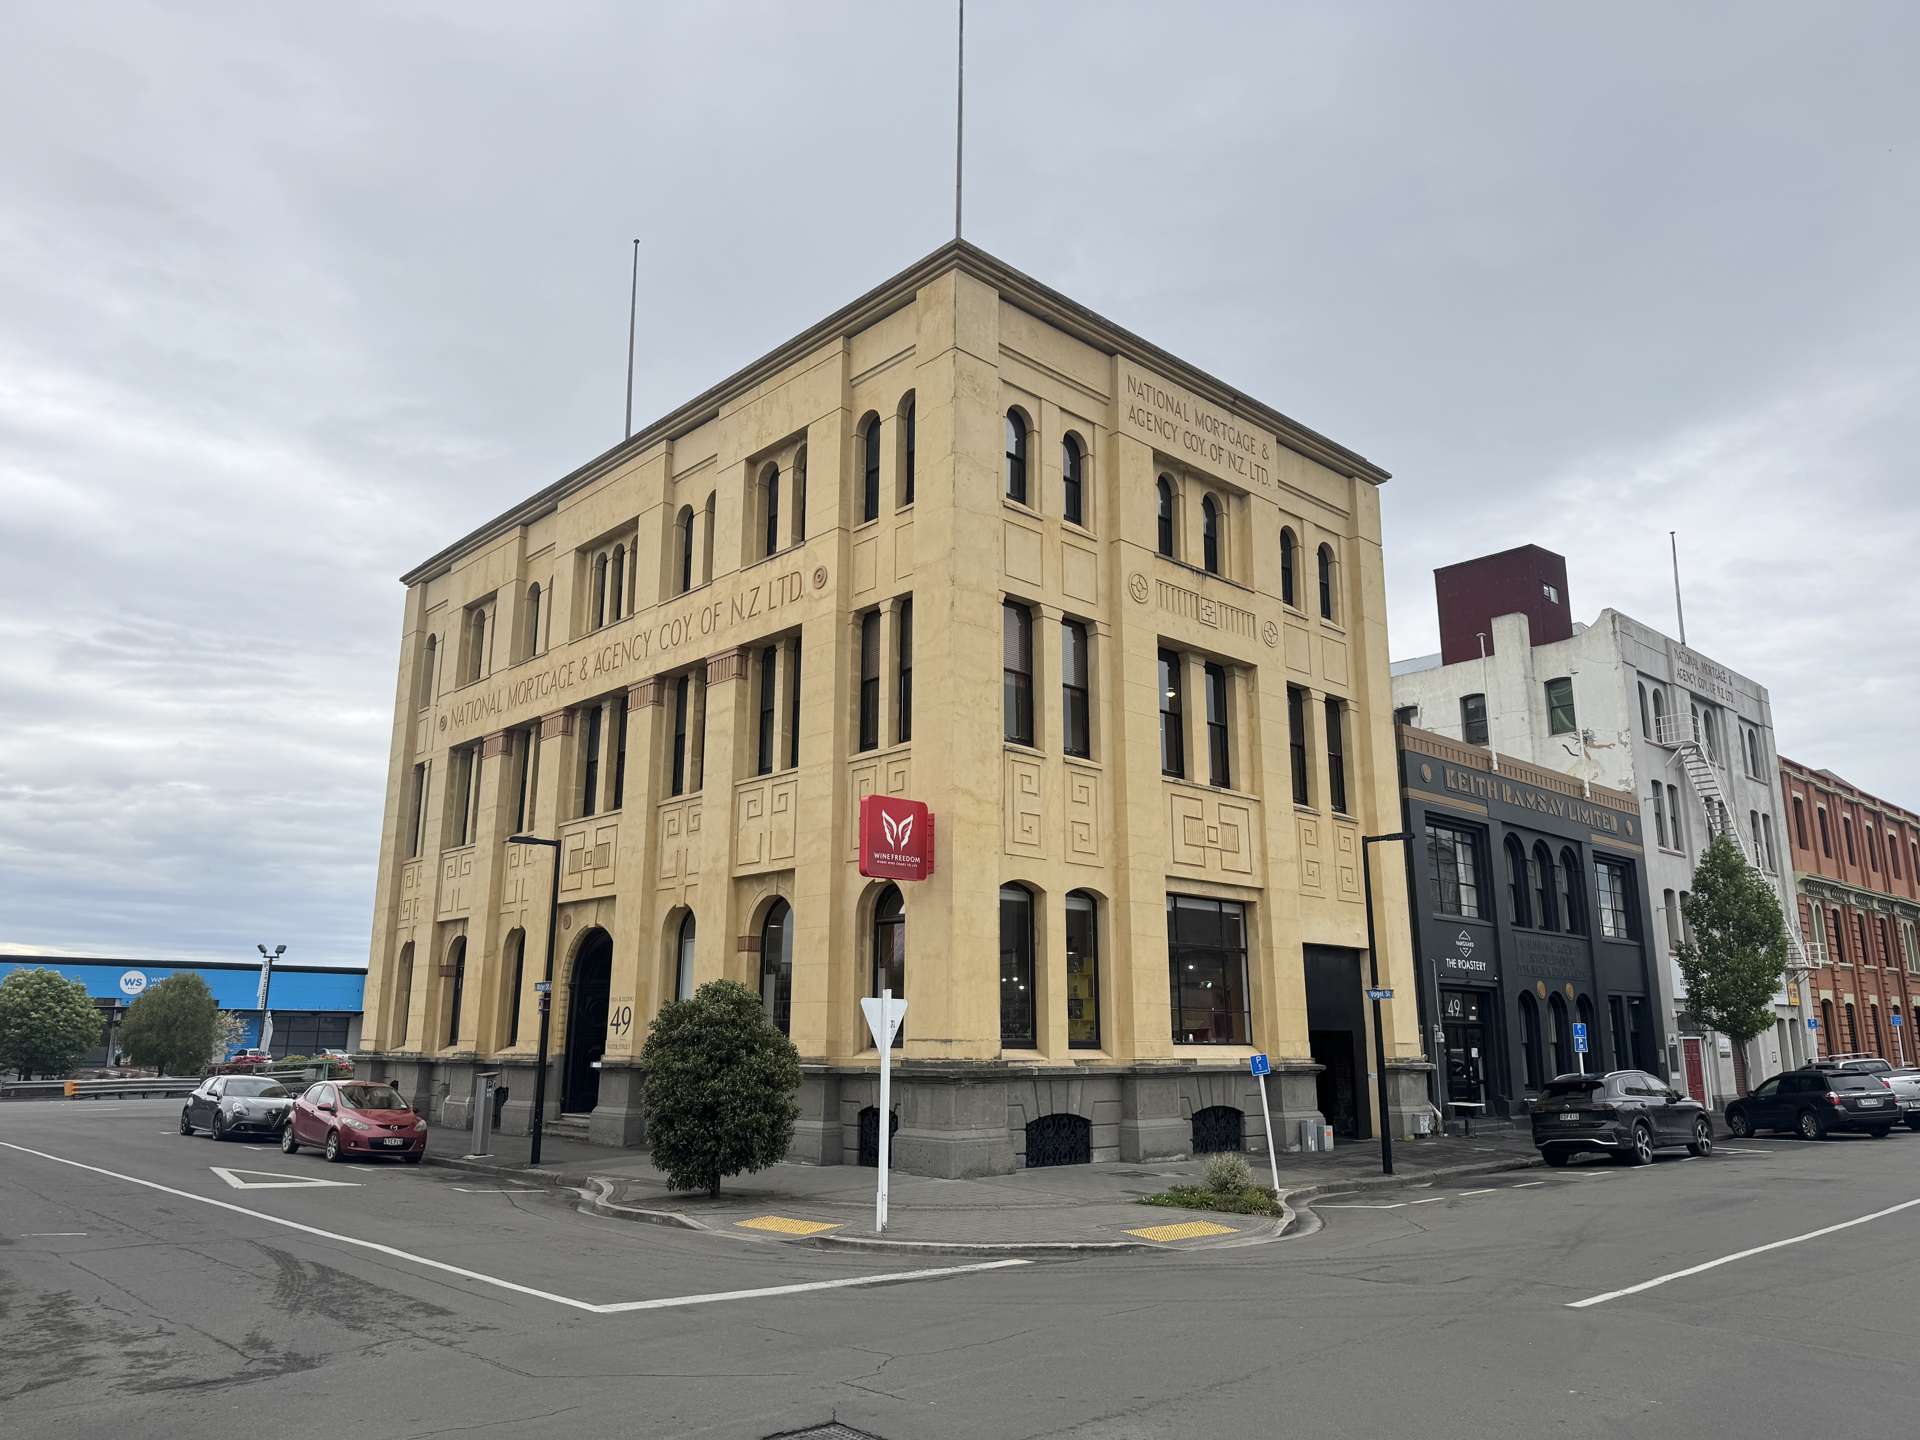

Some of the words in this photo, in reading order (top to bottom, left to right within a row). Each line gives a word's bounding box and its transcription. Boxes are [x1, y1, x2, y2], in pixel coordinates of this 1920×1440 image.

[1127, 375, 1188, 423] NATIONAL
[1194, 408, 1256, 455] MORTGAGE
[1261, 443, 1270, 460] &
[1128, 405, 1178, 443] AGENCY
[1183, 430, 1207, 457] COY.
[1210, 443, 1225, 465] OF
[1249, 461, 1271, 487] LTD.
[450, 688, 503, 730] NATIONAL
[507, 660, 576, 711] MORTGAGE
[579, 656, 589, 682] &
[592, 628, 653, 680] AGENCY
[659, 612, 693, 650] COY.
[700, 601, 723, 636] OF
[730, 585, 762, 626] N.Z.
[767, 570, 804, 612] LTD.
[1446, 767, 1498, 800] KEITH
[1503, 783, 1565, 817] RAMSAY
[1568, 802, 1618, 833] LIMITED
[124, 978, 143, 987] WS
[1445, 957, 1457, 969] THE
[1457, 959, 1486, 971] ROASTERY
[610, 1005, 632, 1036] 49
[1447, 999, 1461, 1017] 49
